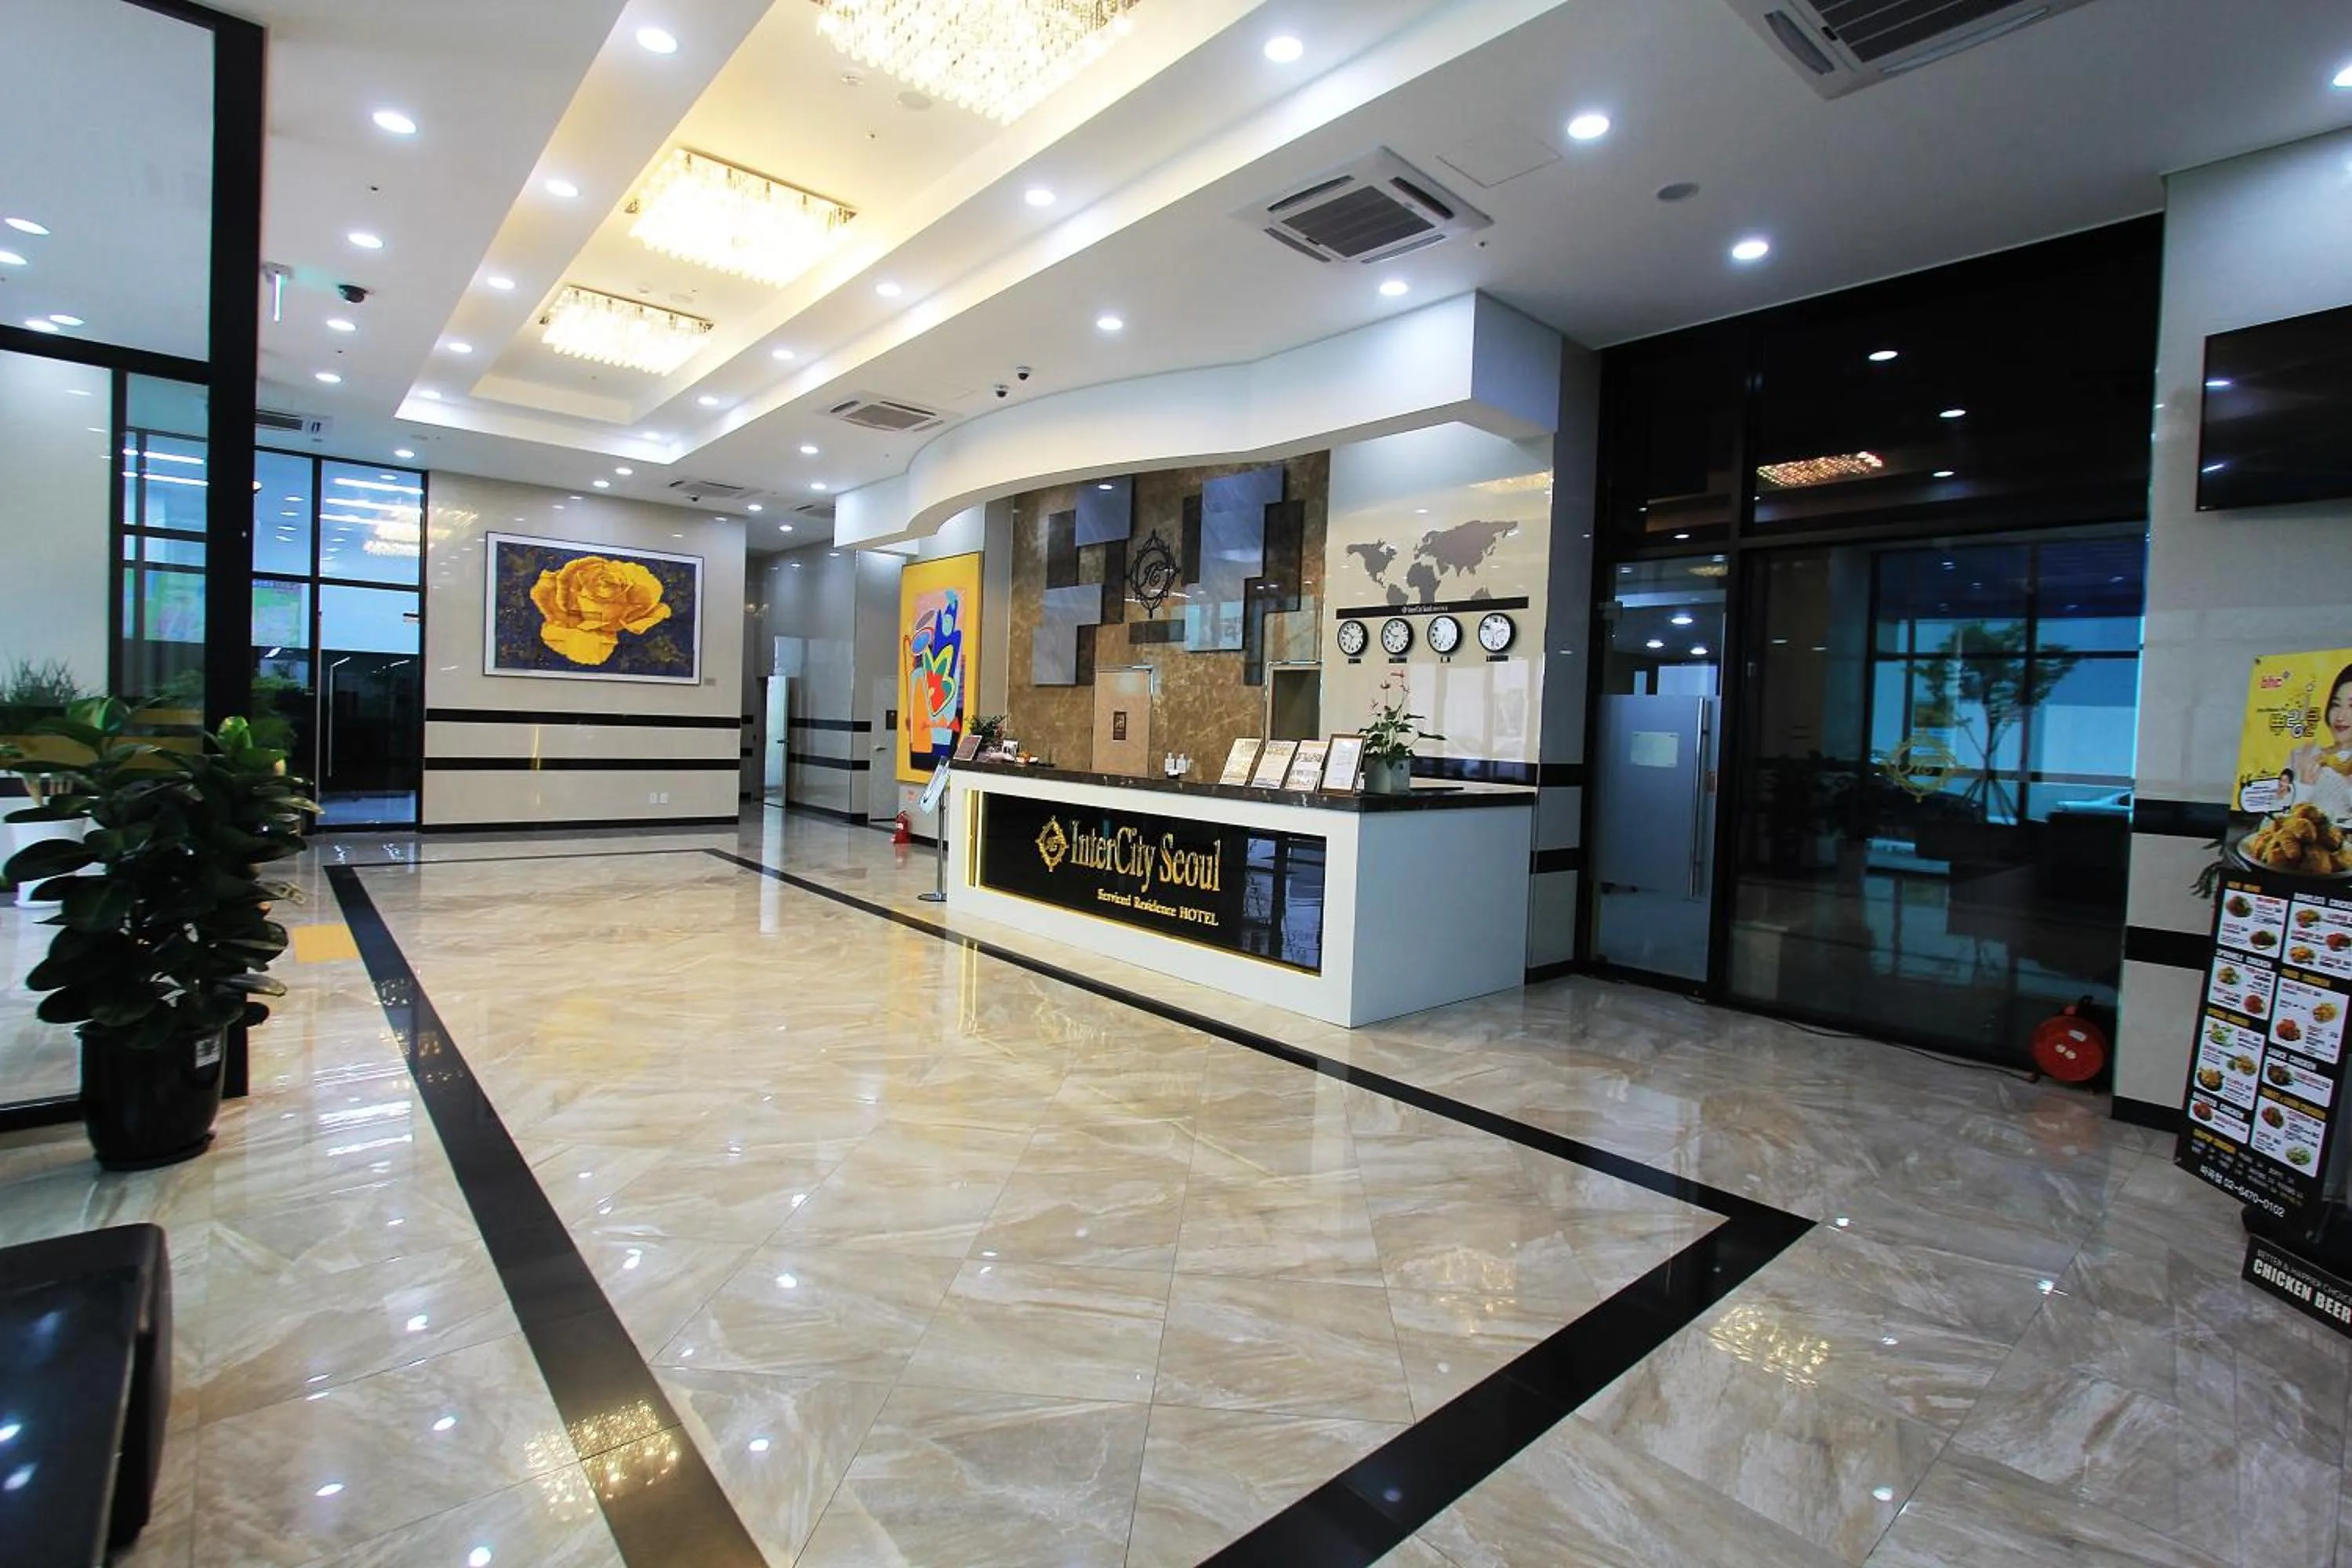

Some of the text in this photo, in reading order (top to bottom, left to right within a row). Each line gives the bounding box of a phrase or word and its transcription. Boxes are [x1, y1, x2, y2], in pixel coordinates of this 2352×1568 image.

[1069, 819, 1221, 893] InterCity Seoul
[1134, 896, 1177, 916] Residence
[1179, 906, 1219, 926] HOTEL
[2253, 1258, 2352, 1324] CHICKEN BEER
